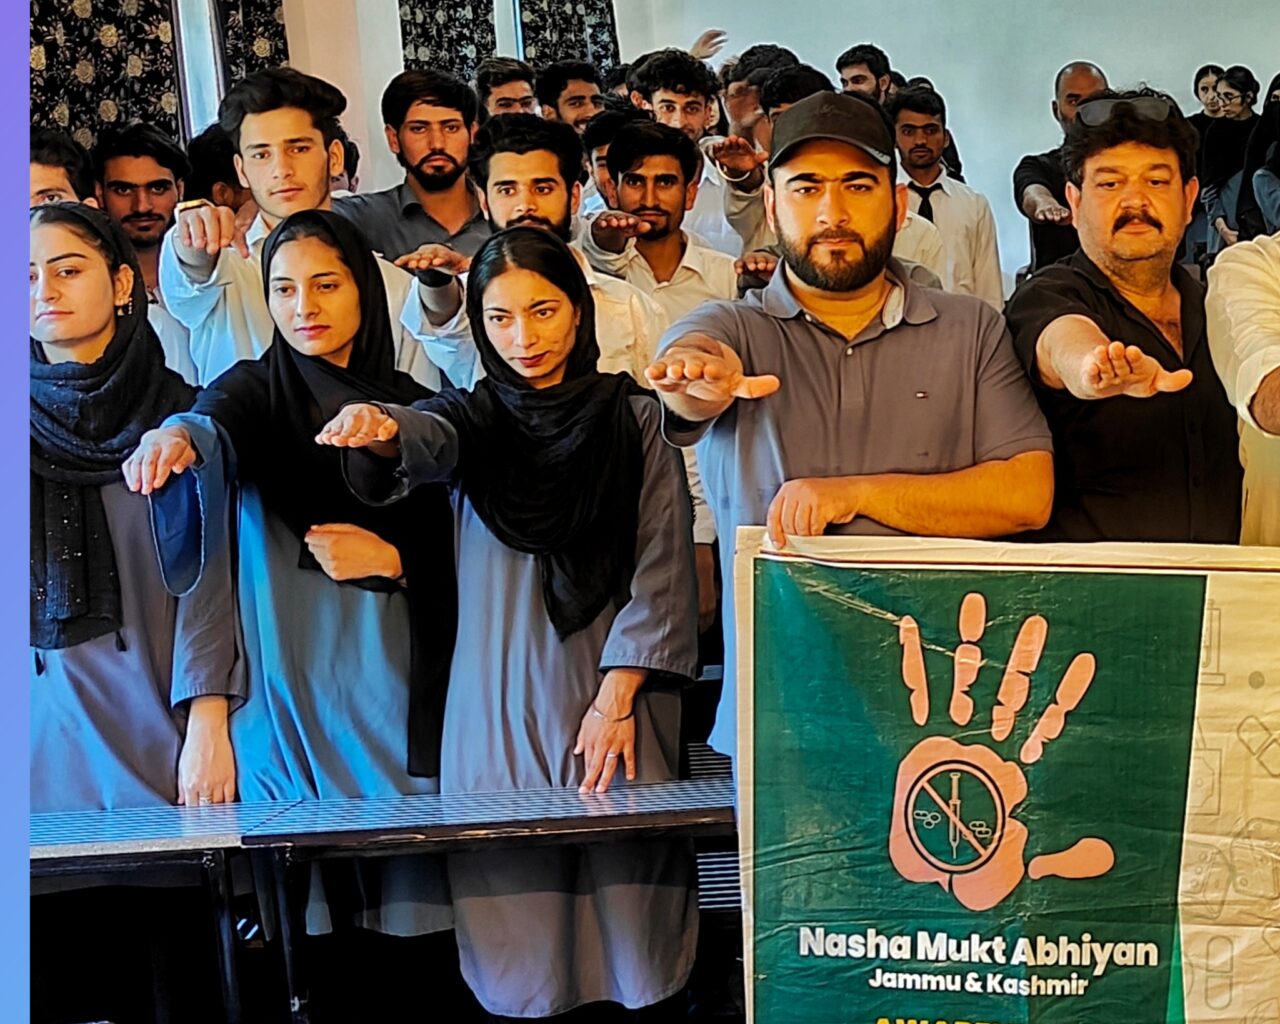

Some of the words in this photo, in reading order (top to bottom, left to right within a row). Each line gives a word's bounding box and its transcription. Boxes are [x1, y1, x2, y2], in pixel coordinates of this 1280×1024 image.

[799, 926, 912, 960] Nasha
[916, 930, 1007, 965] Mukt
[1010, 932, 1159, 977] Abhiyan
[868, 968, 962, 992] Jammu
[964, 971, 984, 993] &
[986, 972, 1089, 997] Kashmir
